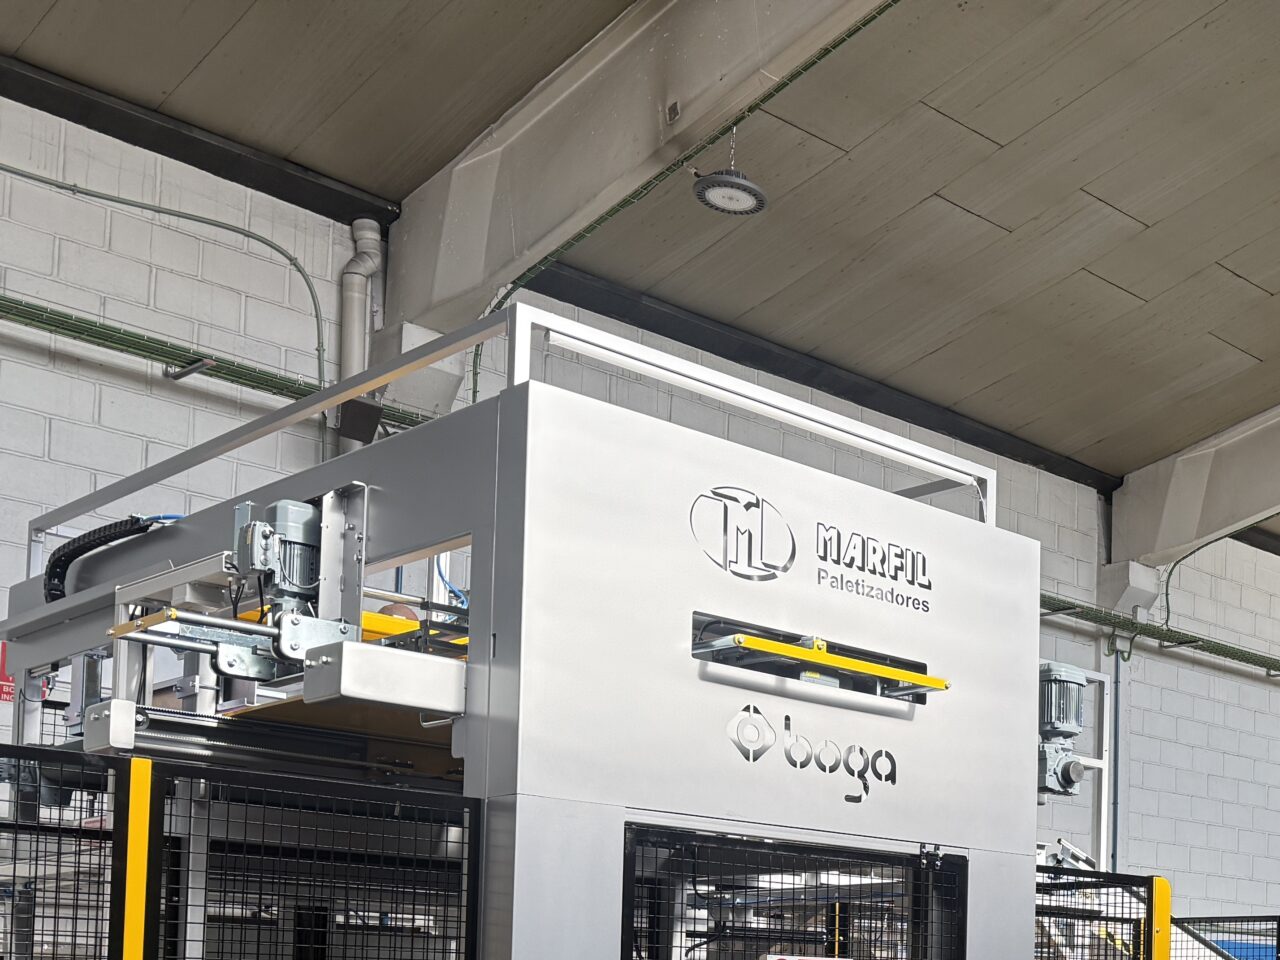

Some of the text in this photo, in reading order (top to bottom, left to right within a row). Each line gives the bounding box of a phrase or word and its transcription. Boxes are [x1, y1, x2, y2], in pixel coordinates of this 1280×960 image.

[816, 522, 932, 590] MARFIL
[816, 567, 930, 613] Paletizadores
[784, 714, 897, 803] boga
